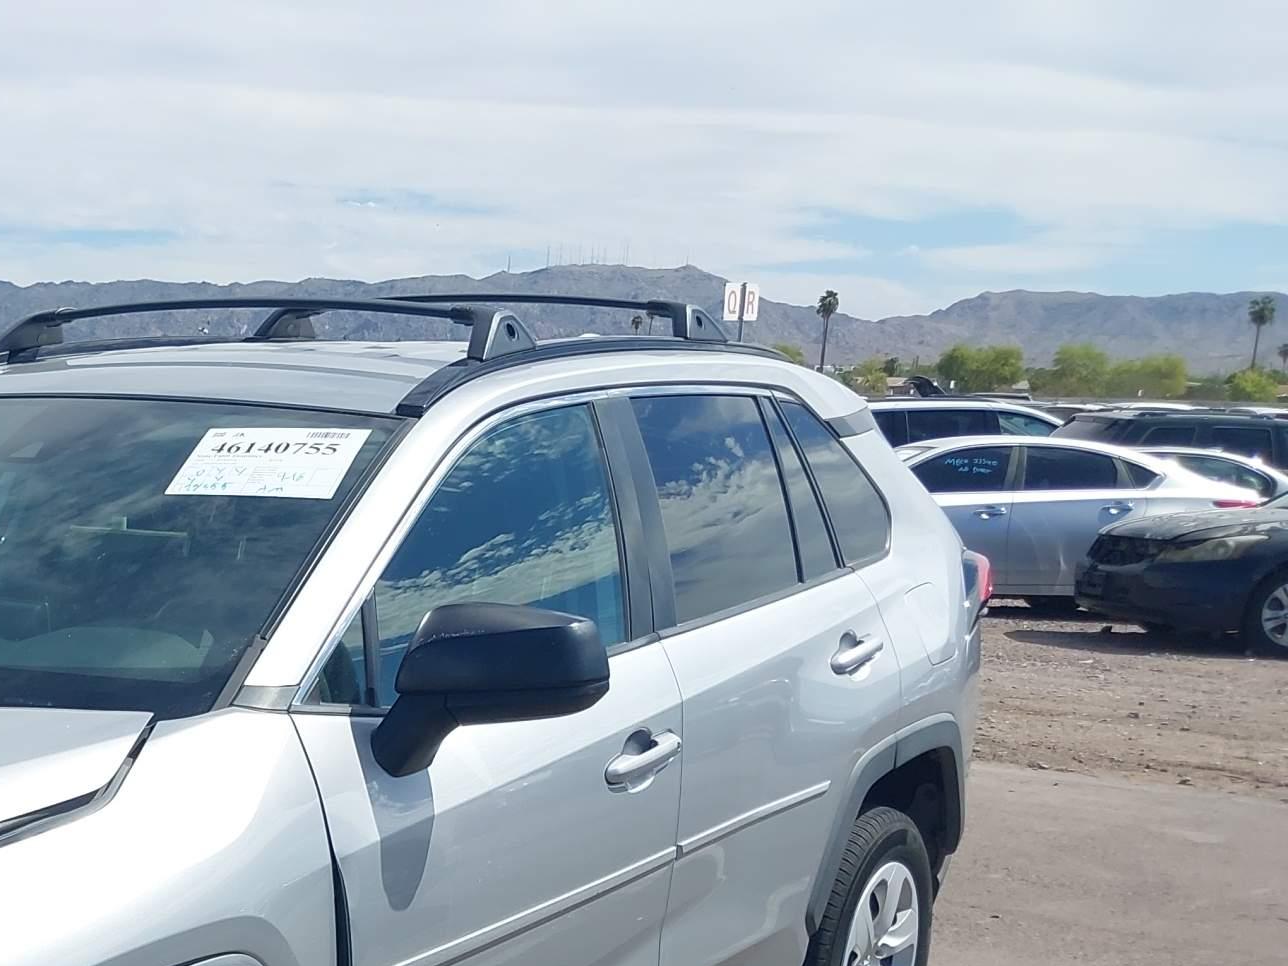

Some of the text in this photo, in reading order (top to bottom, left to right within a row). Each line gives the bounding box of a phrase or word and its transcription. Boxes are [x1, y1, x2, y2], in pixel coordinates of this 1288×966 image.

[727, 290, 738, 315] Q
[745, 290, 756, 315] R
[210, 441, 341, 456] 46140755
